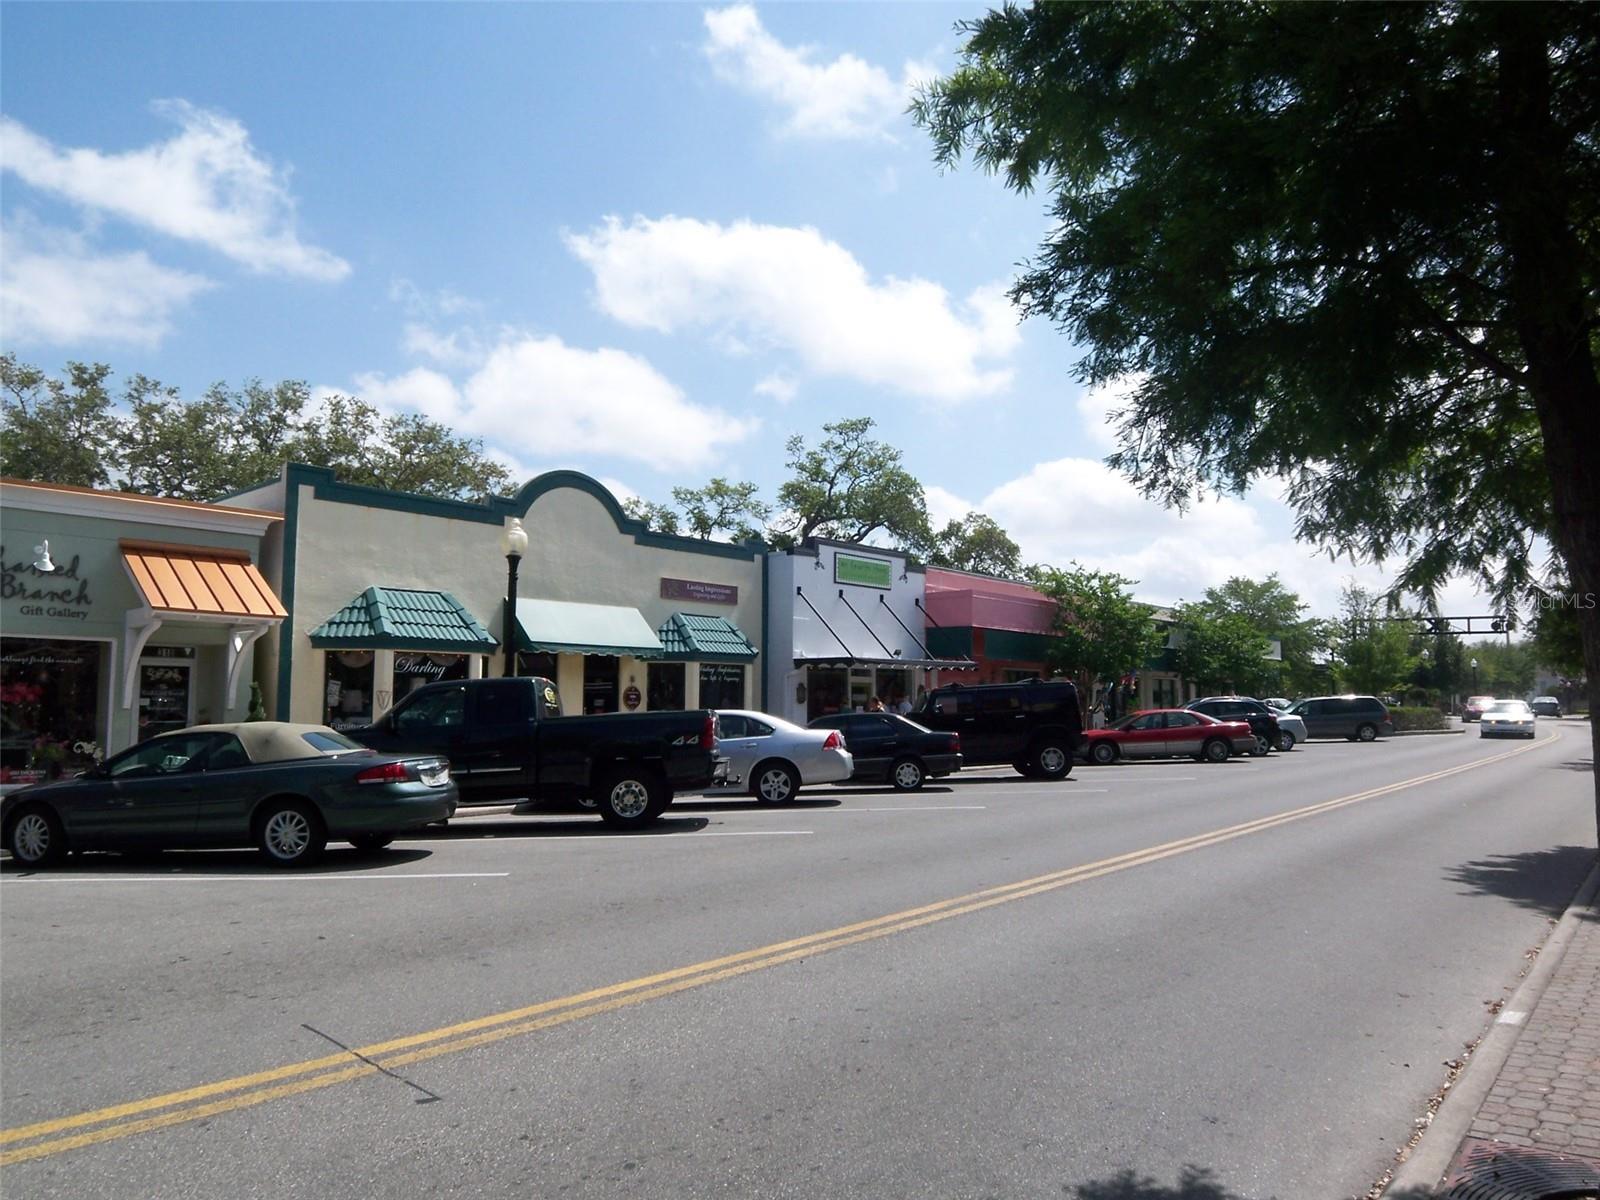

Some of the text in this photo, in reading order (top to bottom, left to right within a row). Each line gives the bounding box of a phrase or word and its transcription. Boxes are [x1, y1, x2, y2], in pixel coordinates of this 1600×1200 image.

[0, 573, 92, 605] Branch
[20, 605, 88, 620] Gift Gallery
[395, 656, 446, 681] Darling
